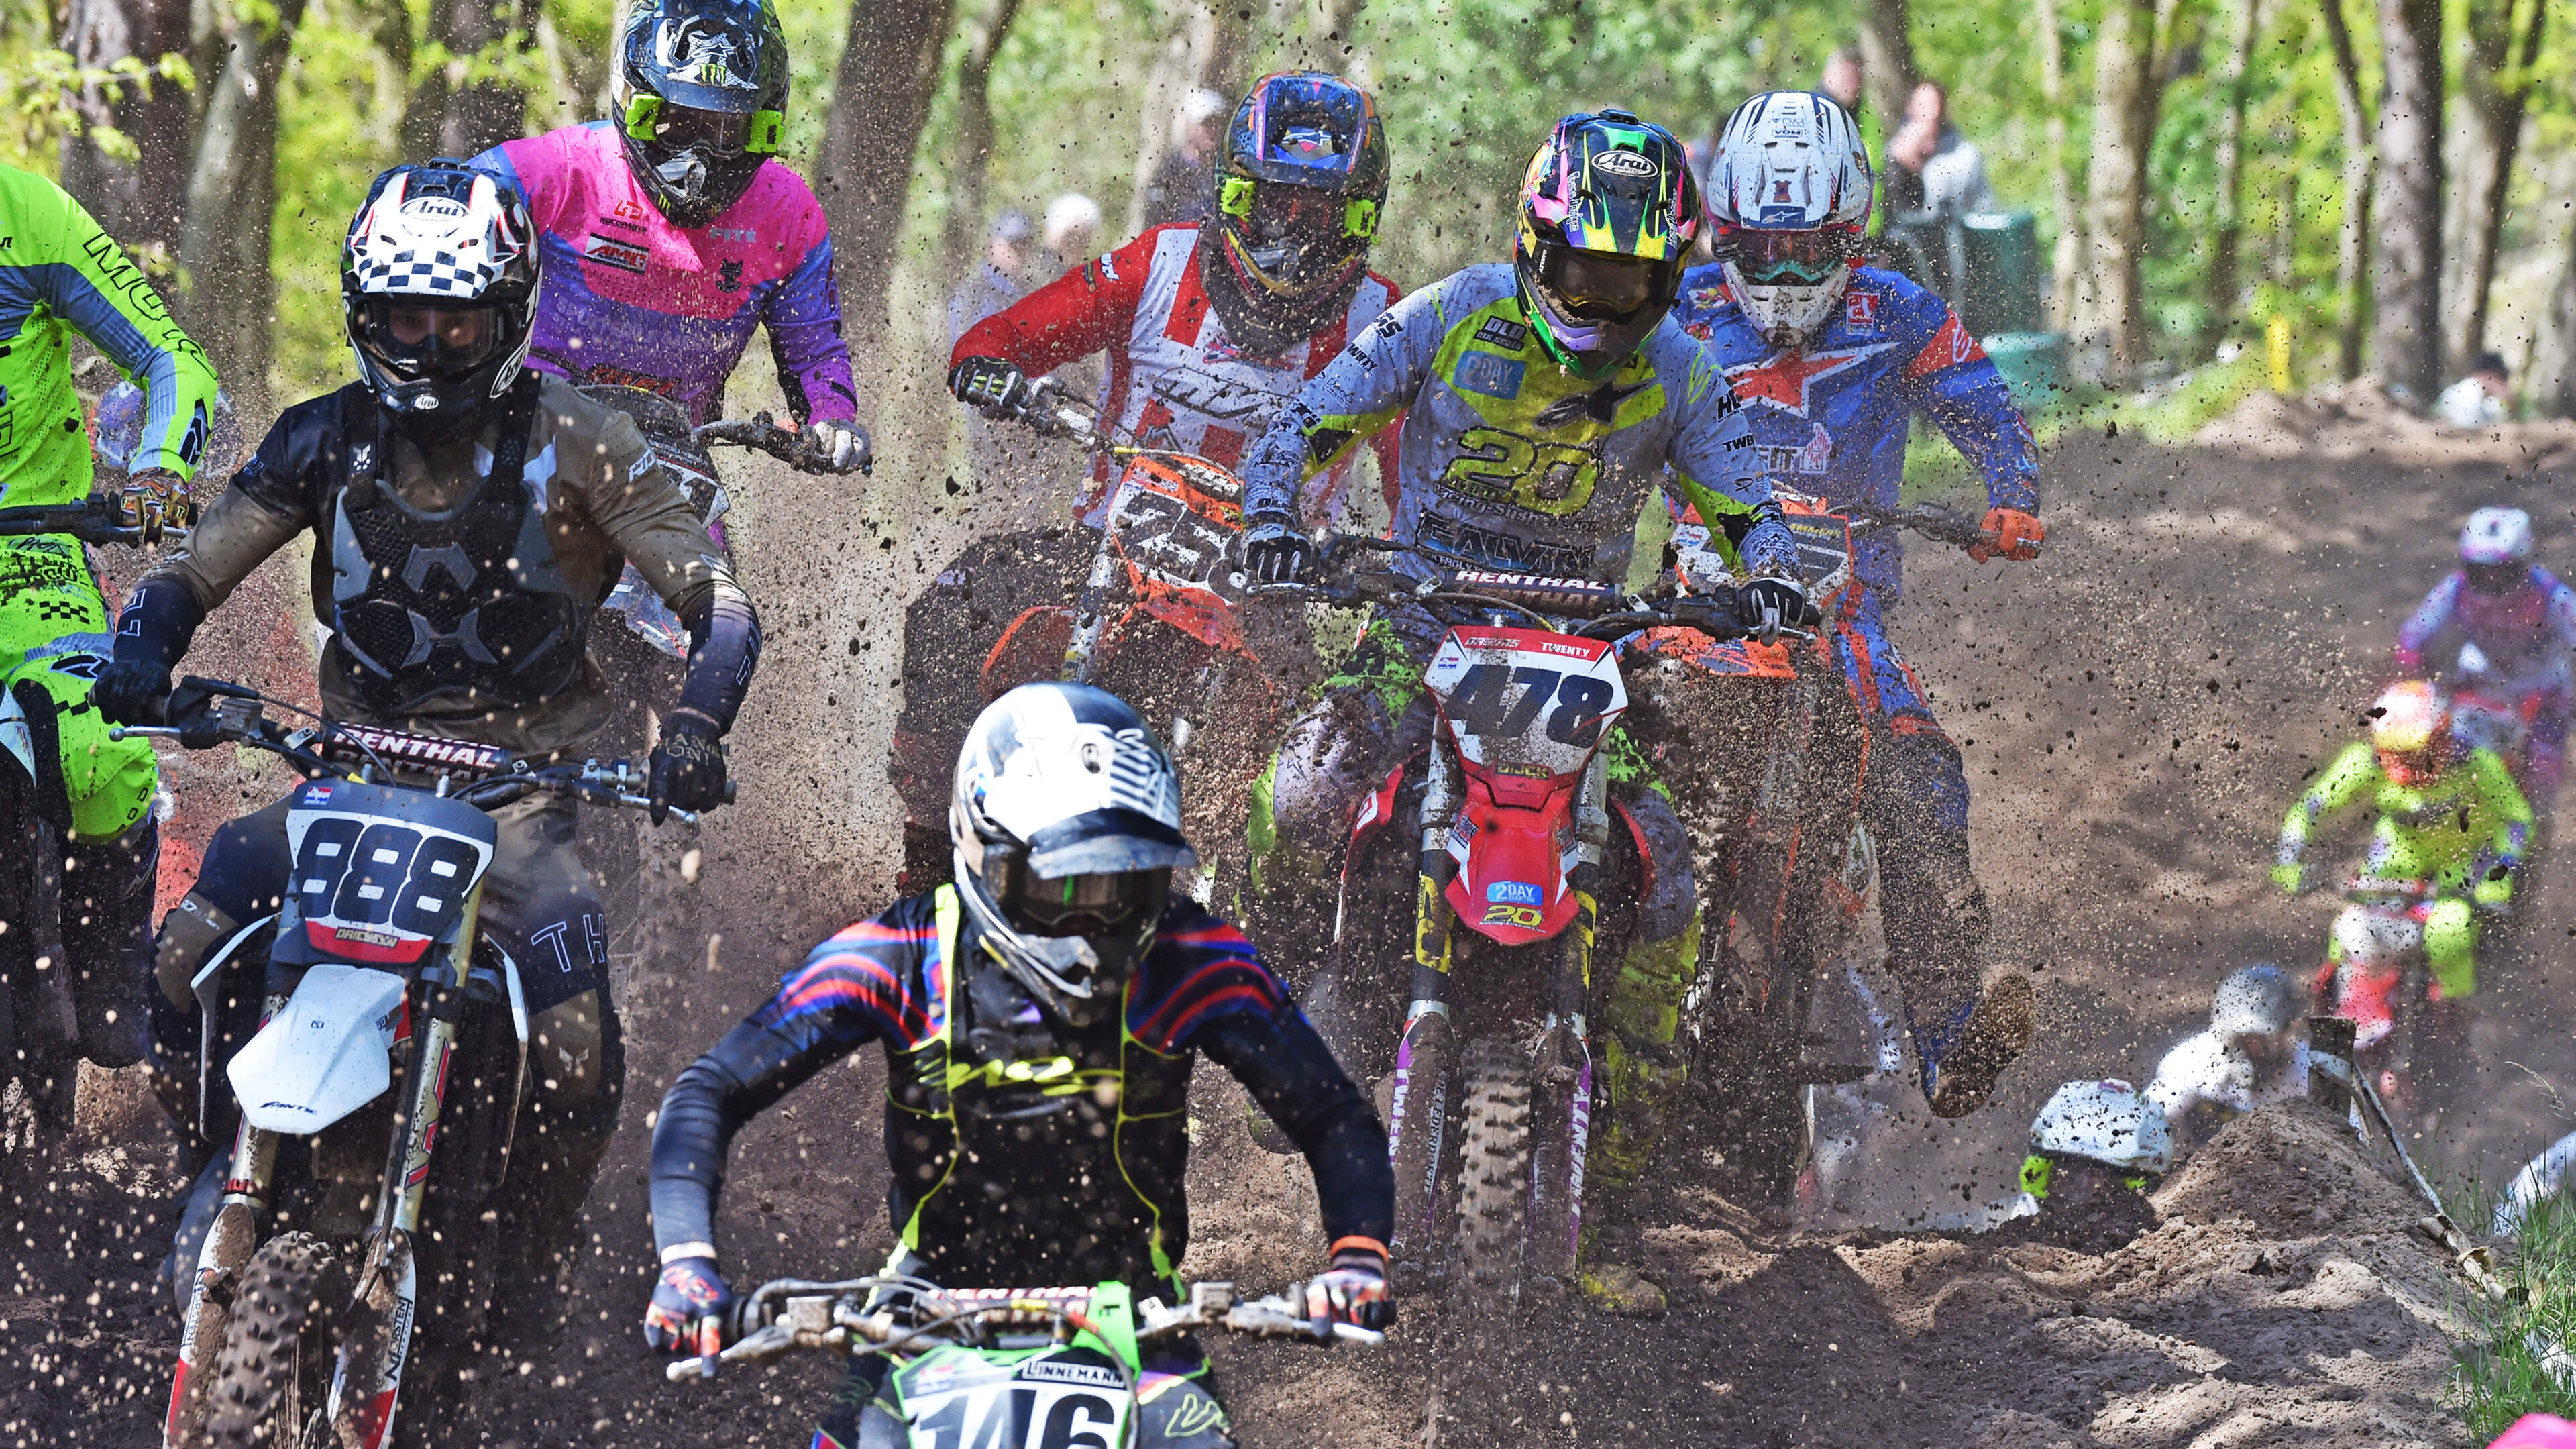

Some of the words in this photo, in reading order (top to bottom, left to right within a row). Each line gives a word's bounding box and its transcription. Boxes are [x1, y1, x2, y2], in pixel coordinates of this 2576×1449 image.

[1598, 154, 1652, 170] Arai
[413, 201, 463, 217] Arai
[1442, 425, 1605, 515] 20
[1454, 570, 1607, 590] RENTHAL
[1540, 642, 1591, 657] TWENTY
[1444, 663, 1614, 749] 478
[333, 728, 497, 769] RENTHAL
[295, 818, 480, 938] 888
[1483, 904, 1544, 927] 20
[918, 1386, 1115, 1449] 146
